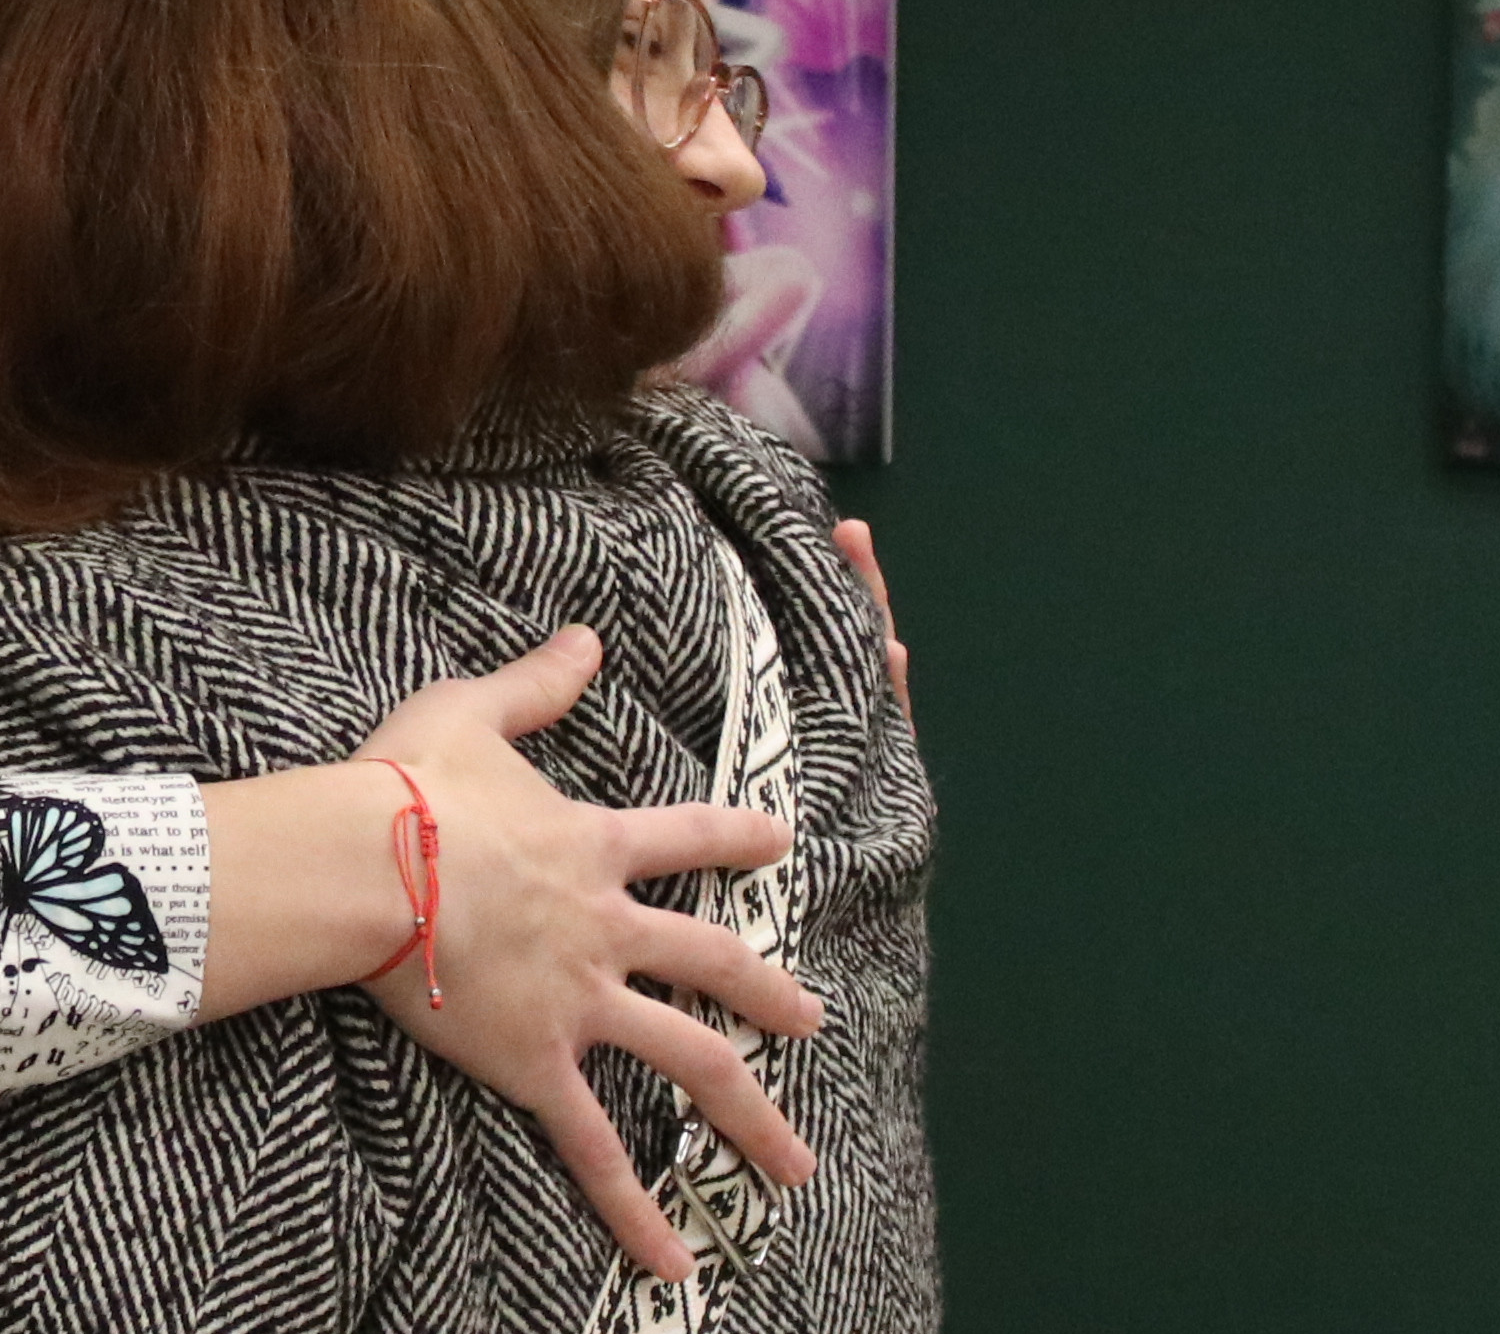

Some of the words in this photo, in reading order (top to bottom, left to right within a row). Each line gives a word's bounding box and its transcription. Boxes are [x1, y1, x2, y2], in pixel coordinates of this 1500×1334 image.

[150, 809, 179, 821] you
[190, 808, 205, 818] to
[127, 825, 159, 837] start
[167, 826, 182, 837] to
[121, 845, 132, 856] is
[140, 844, 174, 857] what
